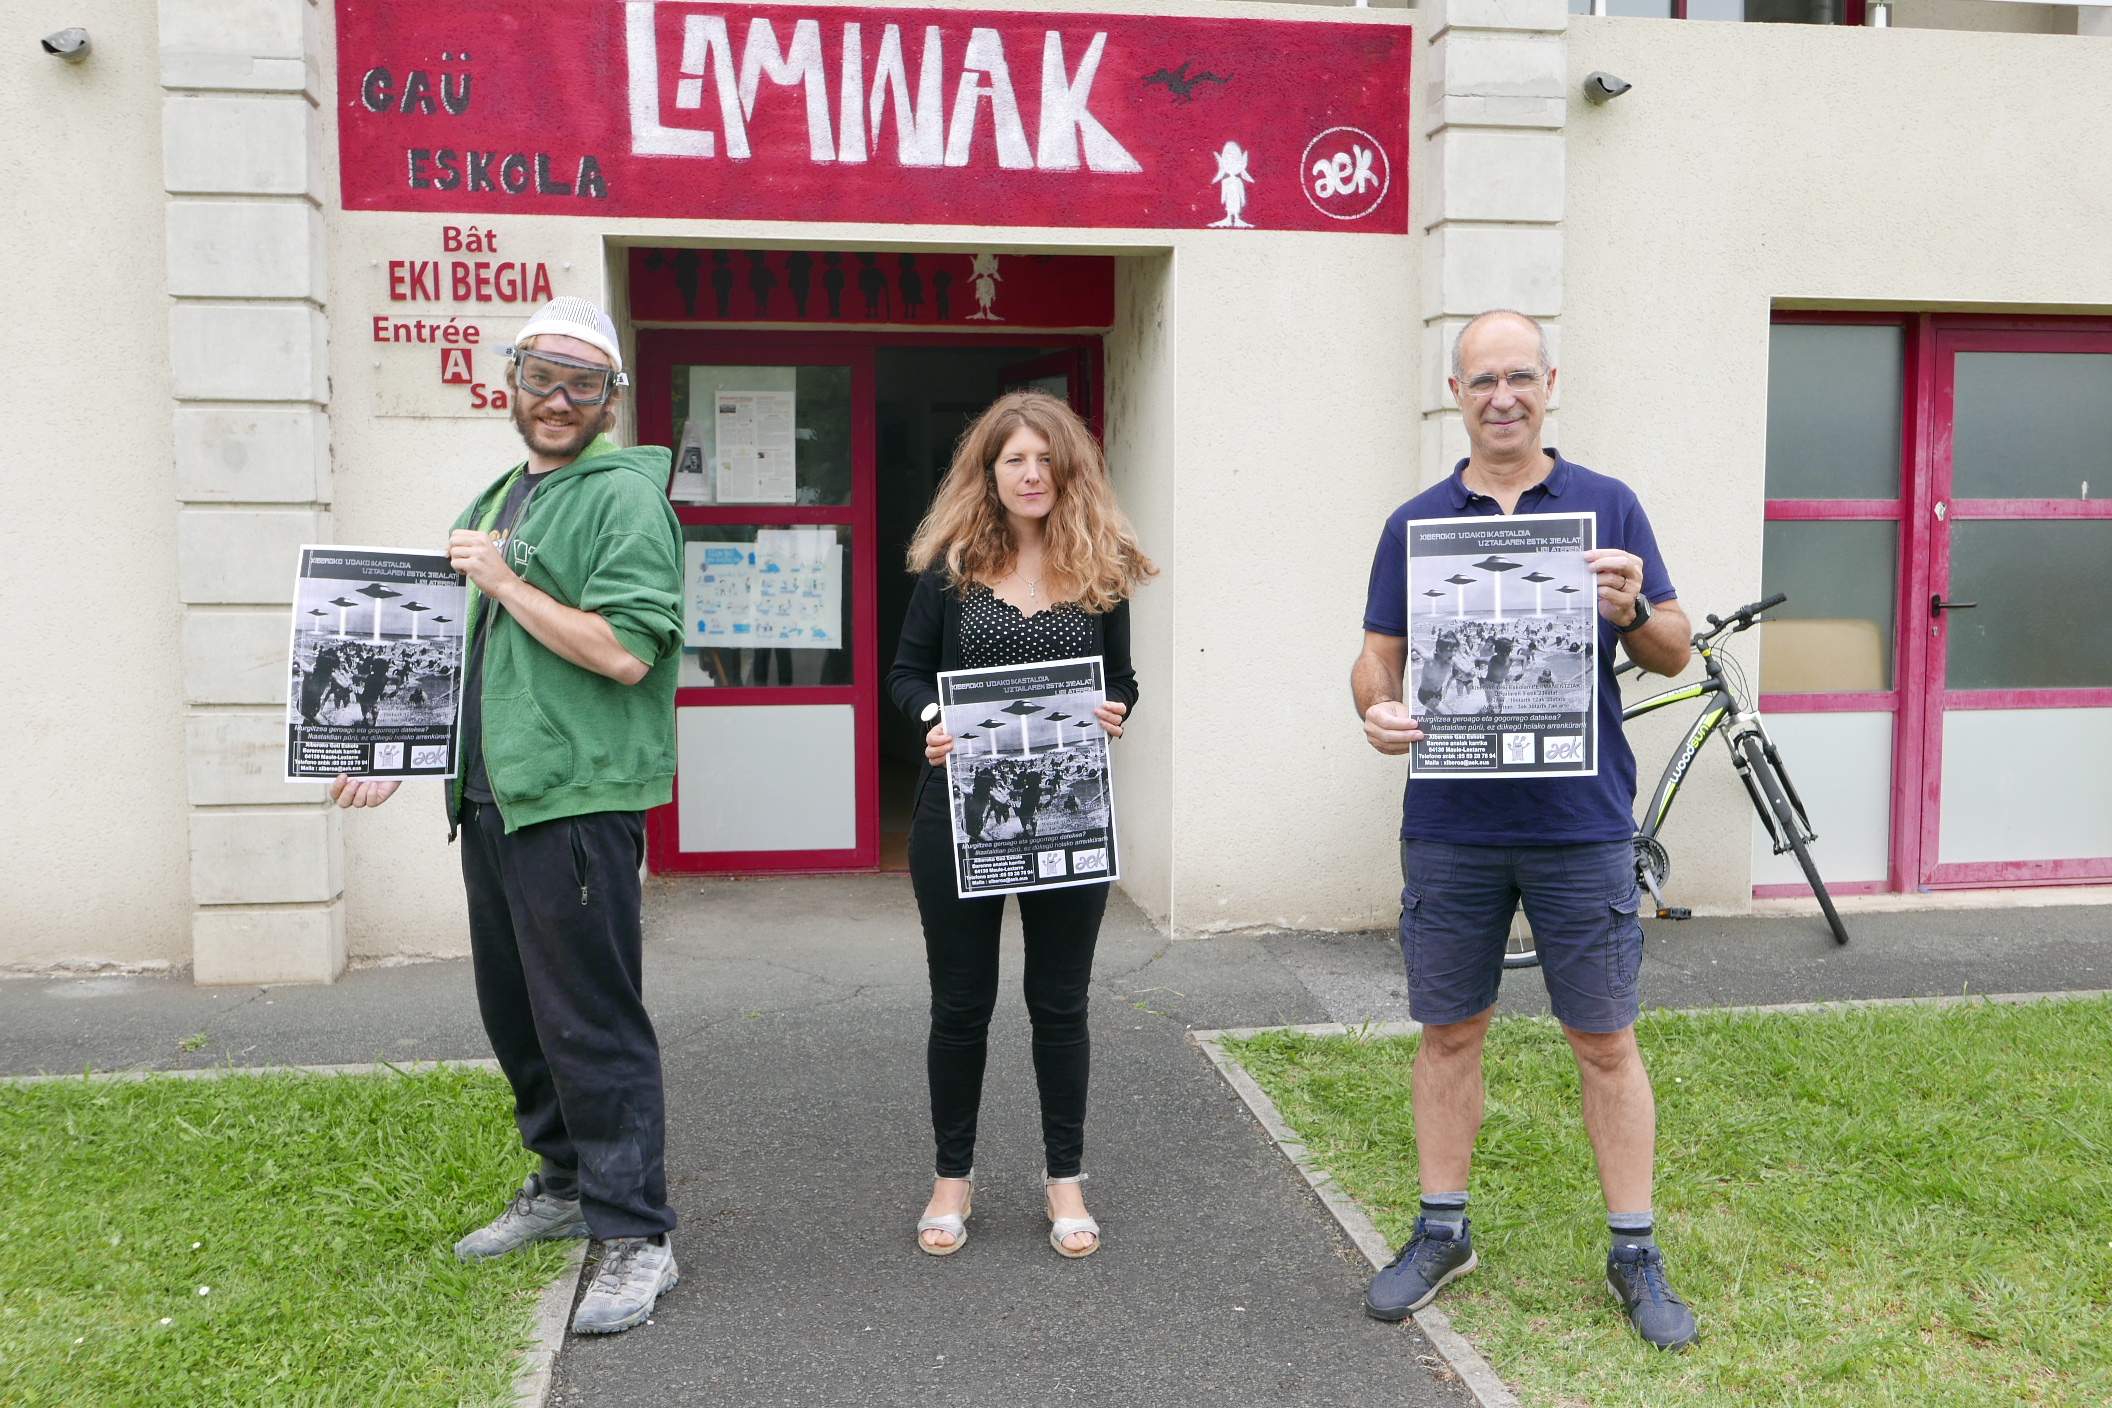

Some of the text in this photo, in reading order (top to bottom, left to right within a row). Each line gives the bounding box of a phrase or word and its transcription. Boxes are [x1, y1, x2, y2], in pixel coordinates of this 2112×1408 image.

[625, 1, 1143, 173] LAMINAK
[406, 149, 609, 199] ESKOLA
[1312, 144, 1379, 199] aek
[442, 225, 498, 253] Bât
[388, 260, 554, 302] EKI BEGIA
[372, 316, 480, 344] Entrée
[443, 350, 472, 382] A
[470, 383, 508, 410] Sa
[1669, 724, 1710, 784] woodsun
